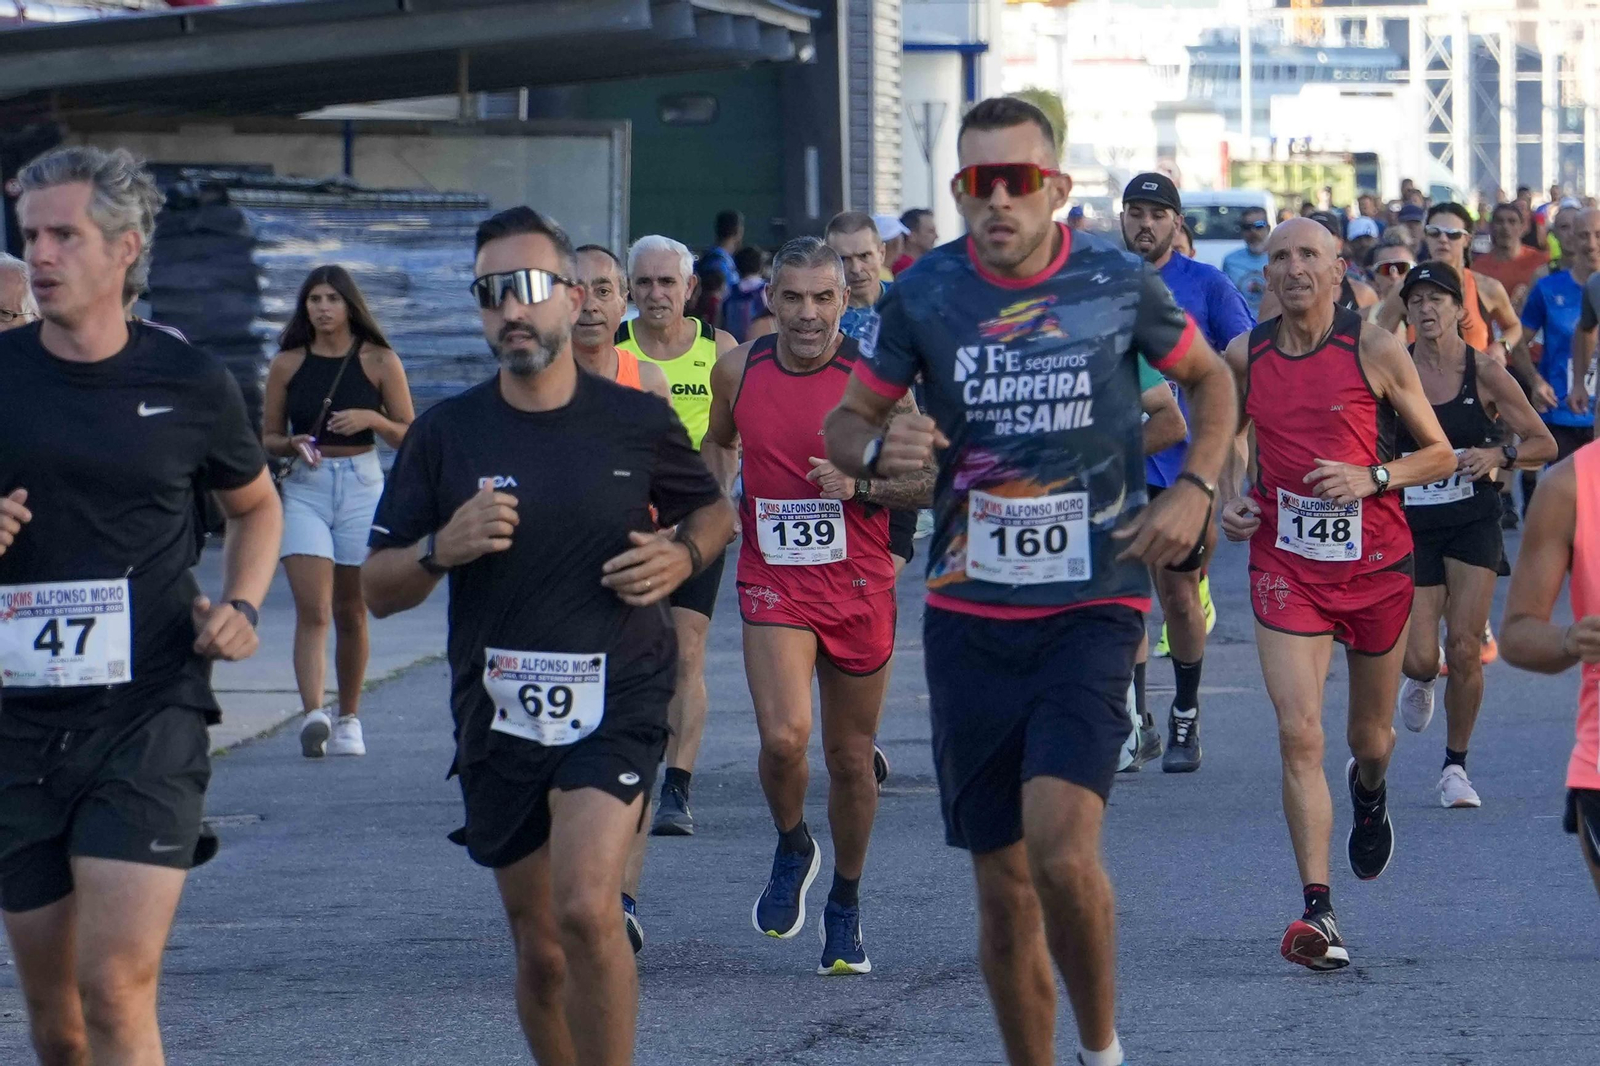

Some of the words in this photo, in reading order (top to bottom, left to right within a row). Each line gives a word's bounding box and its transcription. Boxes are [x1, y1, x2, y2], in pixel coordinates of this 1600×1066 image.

[1025, 353, 1087, 372] seguros
[963, 371, 1091, 405] CARREIRA
[965, 408, 1013, 423] PRAIA
[995, 422, 1013, 435] DE
[1013, 399, 1094, 434] SAMIL
[760, 502, 780, 513] 10KMS
[782, 503, 816, 513] ALFONSO
[818, 502, 840, 512] MORO
[1005, 503, 1052, 517] ALFONSO
[1055, 498, 1084, 513] MORO
[1301, 500, 1335, 511] ALFONSO
[772, 520, 835, 547] 139
[990, 524, 1068, 558] 160
[1292, 515, 1351, 543] 148
[1, 591, 33, 607] 10KMS
[36, 588, 87, 605] ALFONSO
[91, 586, 124, 602] MORO
[55, 606, 92, 615] SETEMBRO
[34, 617, 97, 657] 47
[521, 658, 569, 672] ALFONSO
[518, 683, 574, 719] 69
